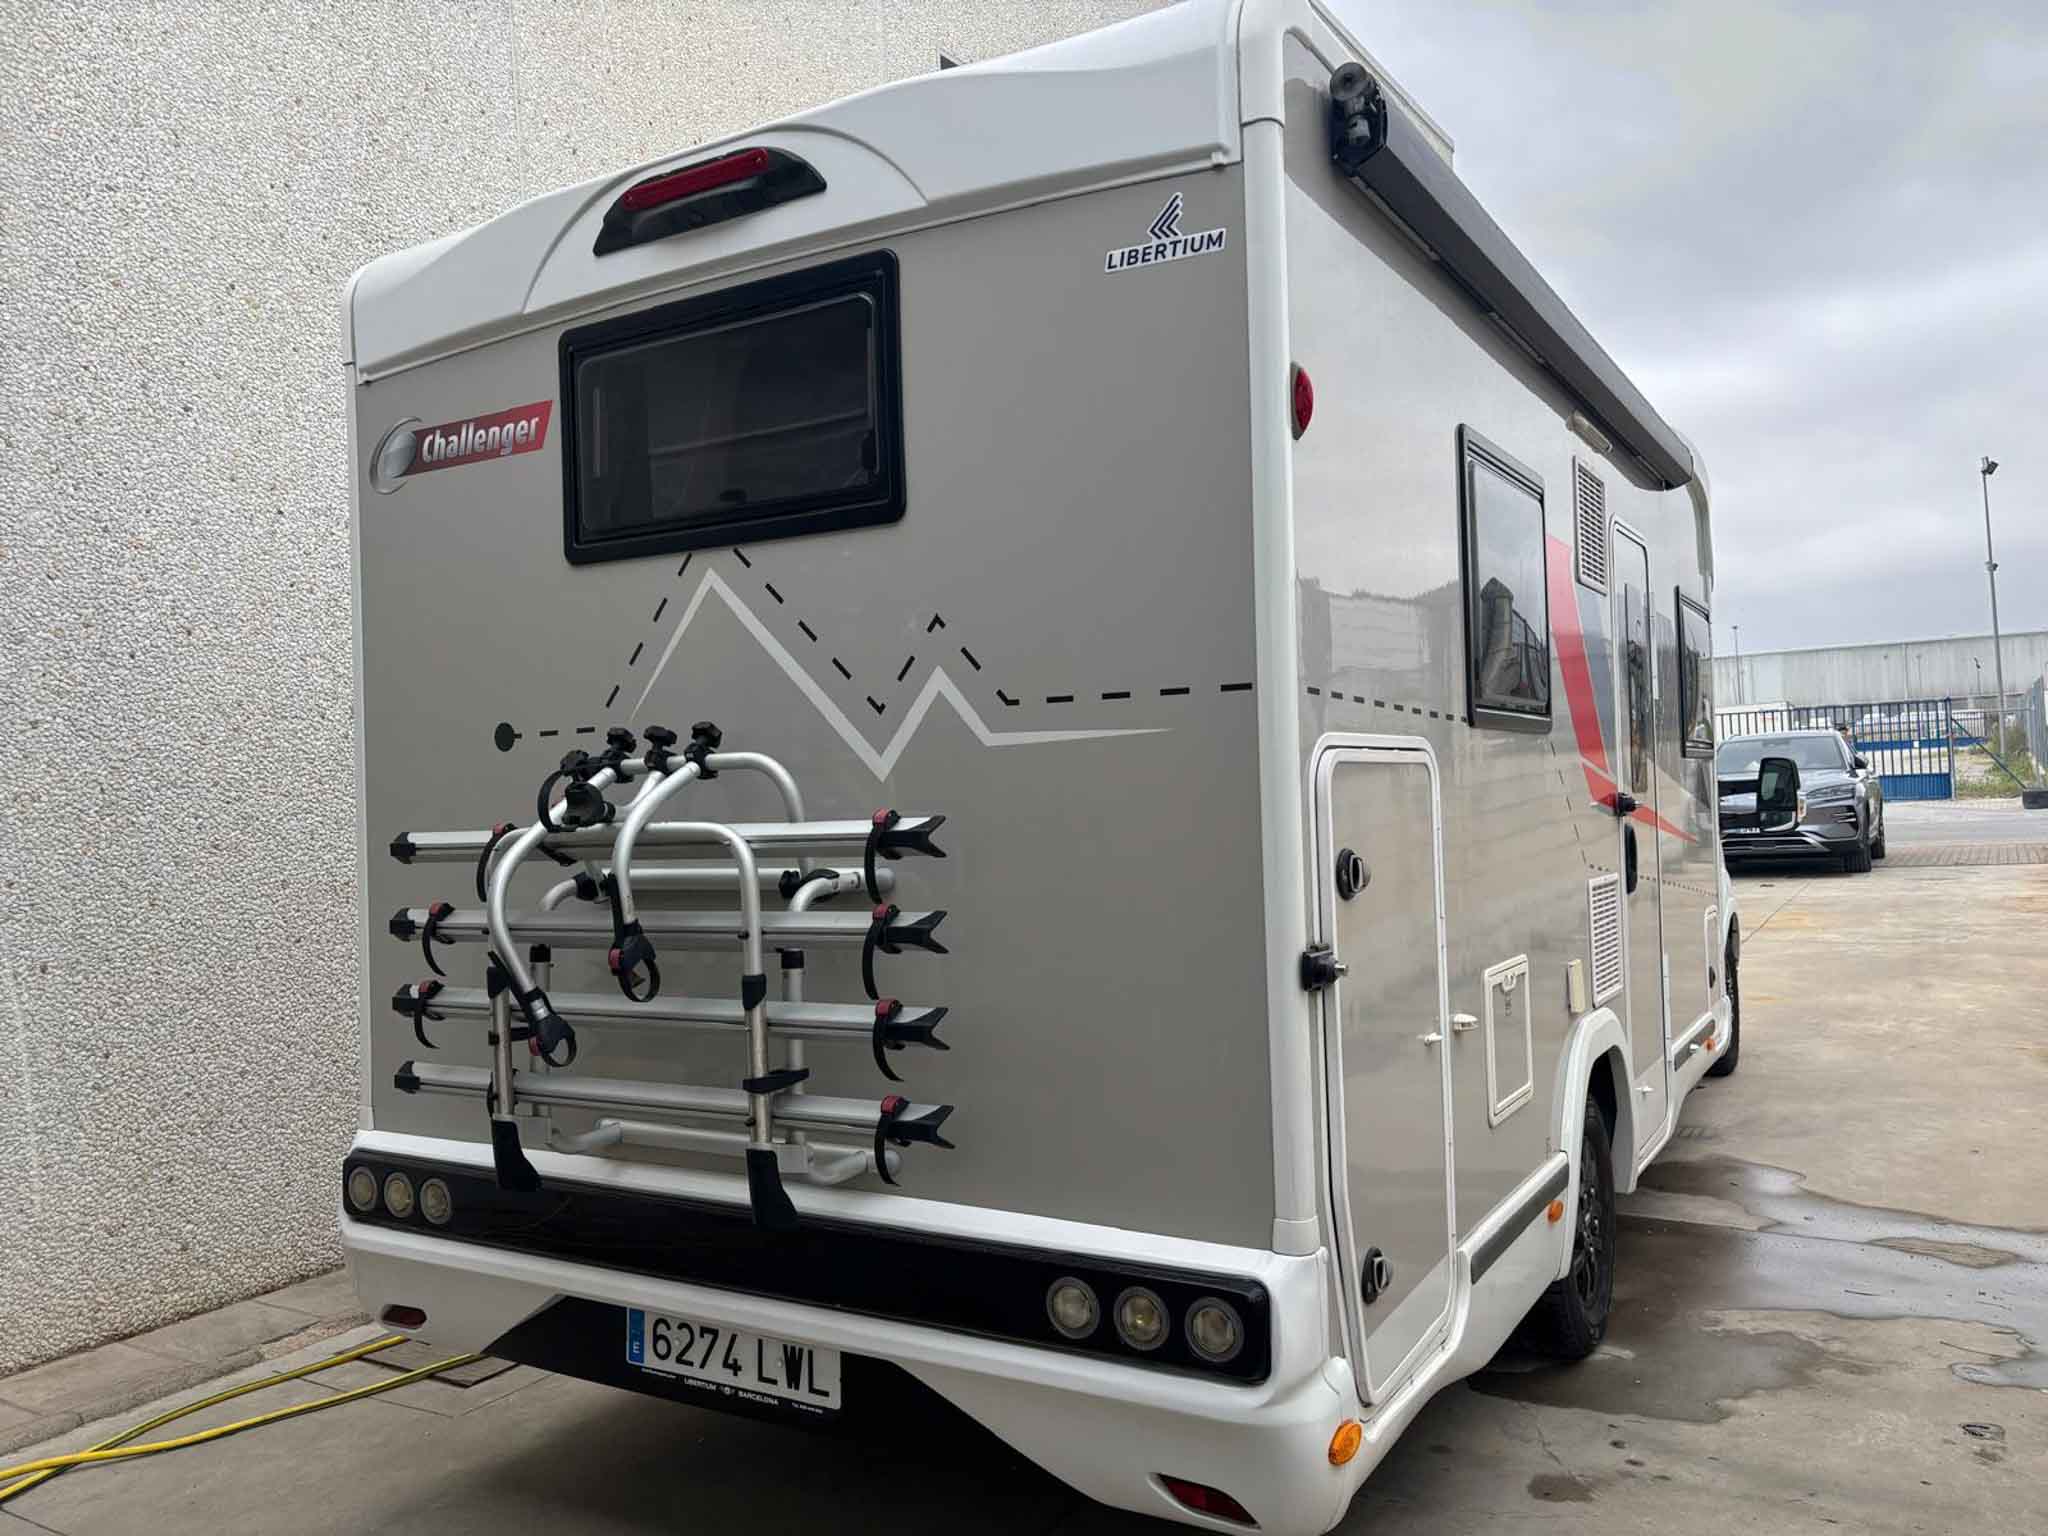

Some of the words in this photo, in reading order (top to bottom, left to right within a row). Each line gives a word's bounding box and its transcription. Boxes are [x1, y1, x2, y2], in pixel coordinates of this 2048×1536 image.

[1107, 231, 1224, 270] LIBERTIUM
[422, 416, 540, 463] Challenger
[652, 1317, 742, 1377] 6274
[757, 1338, 830, 1398] LWL
